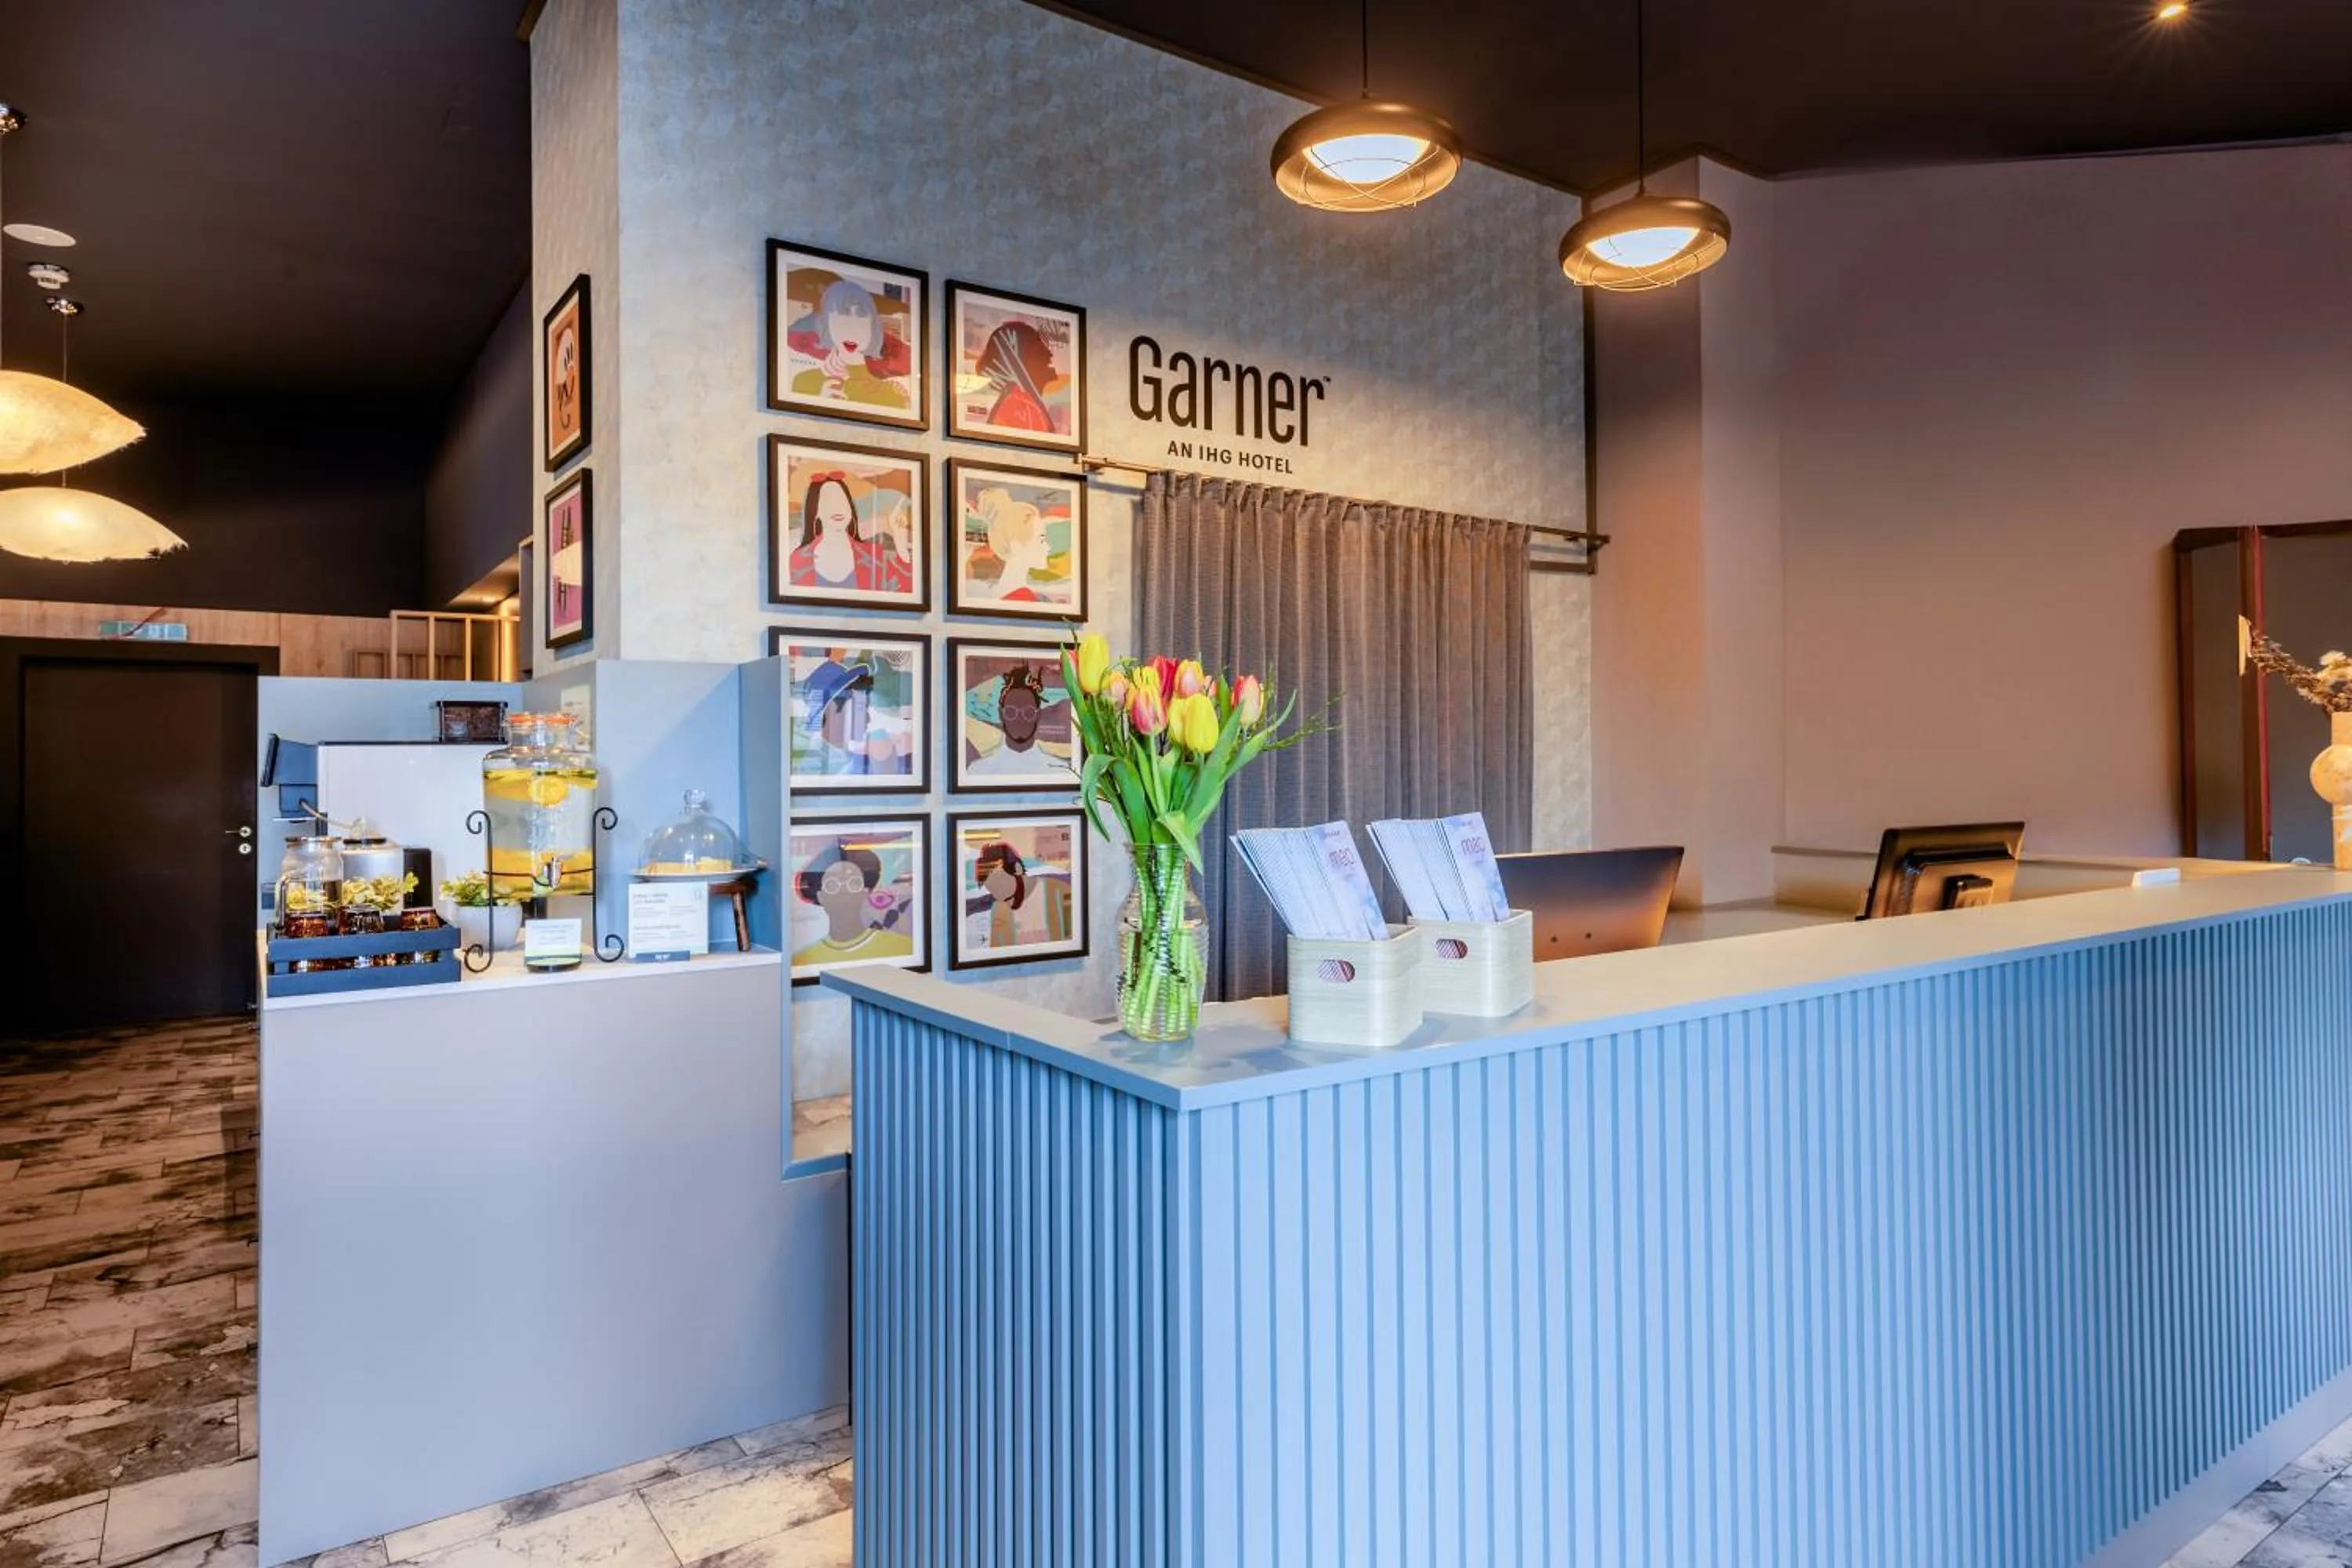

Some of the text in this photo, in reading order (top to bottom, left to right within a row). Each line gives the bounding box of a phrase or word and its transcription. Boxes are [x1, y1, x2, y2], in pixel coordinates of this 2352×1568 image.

[1167, 440, 1293, 474] AN IHG HOTEL
